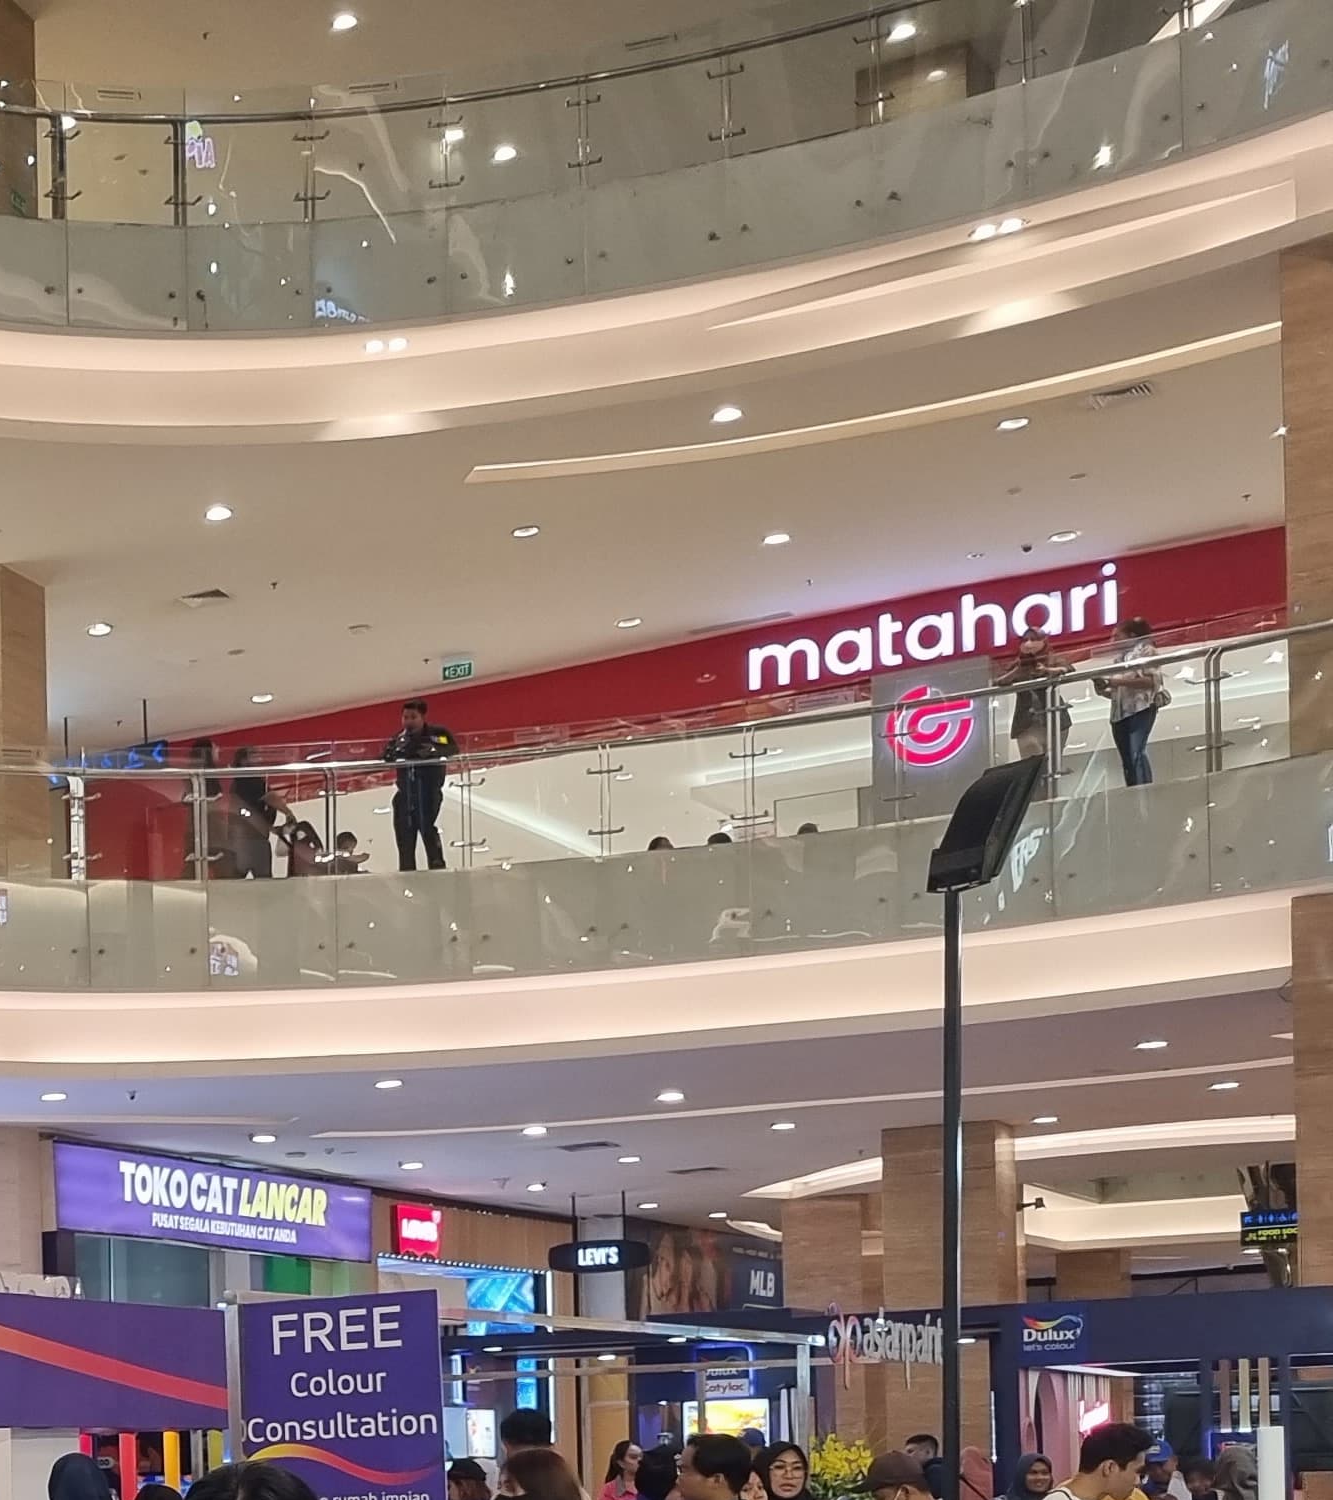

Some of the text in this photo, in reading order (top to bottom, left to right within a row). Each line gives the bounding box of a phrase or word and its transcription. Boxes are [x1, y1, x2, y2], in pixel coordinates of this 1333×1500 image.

[746, 562, 1119, 691] matahari
[447, 663, 470, 678] EXIT
[119, 1160, 327, 1226] TOKO CAT LANCAR
[152, 1212, 297, 1244] PUSAT SEGALA KEBUTUHAN CAT ANDA
[577, 1246, 619, 1266] LEVI'S
[749, 1269, 775, 1298] MLB
[271, 1305, 403, 1355] FREE
[1023, 1328, 1075, 1342] Dulux
[863, 1306, 943, 1391] asianpaint
[290, 1368, 387, 1397] Colour
[248, 1408, 438, 1443] Consultation
